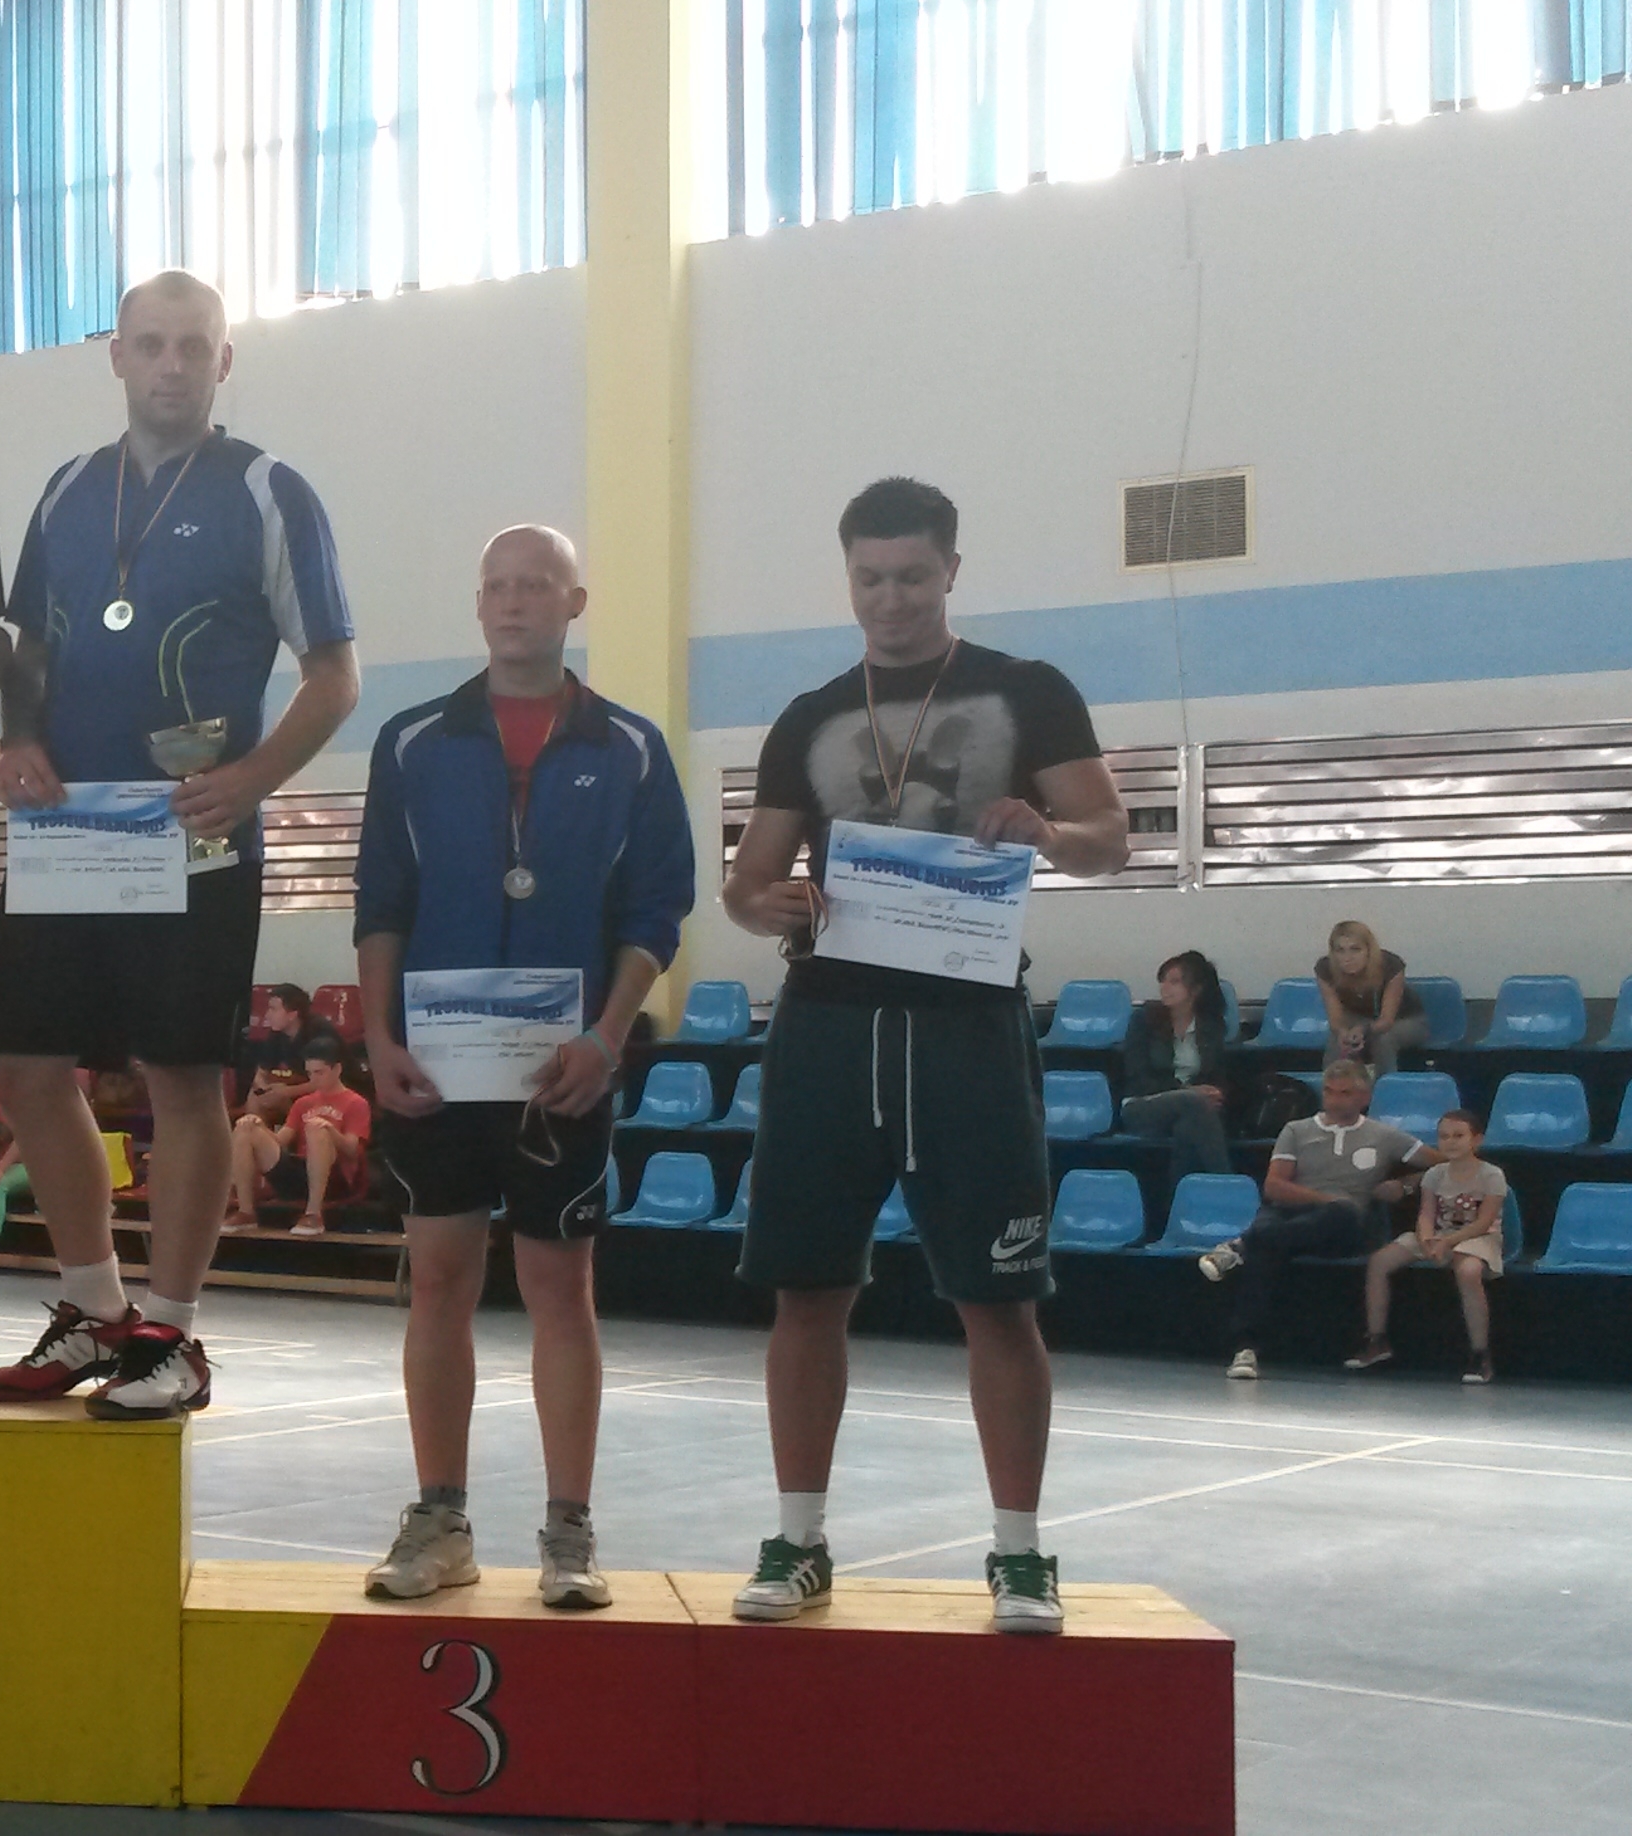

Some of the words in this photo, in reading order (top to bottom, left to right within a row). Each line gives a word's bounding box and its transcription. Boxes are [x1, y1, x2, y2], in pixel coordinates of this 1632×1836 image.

[26, 814, 92, 831] TROFEUL
[851, 857, 922, 881] TROFEUL
[1004, 1214, 1043, 1240] NIKE
[992, 1260, 1021, 1275] TRACK
[410, 1639, 508, 1797] 3
